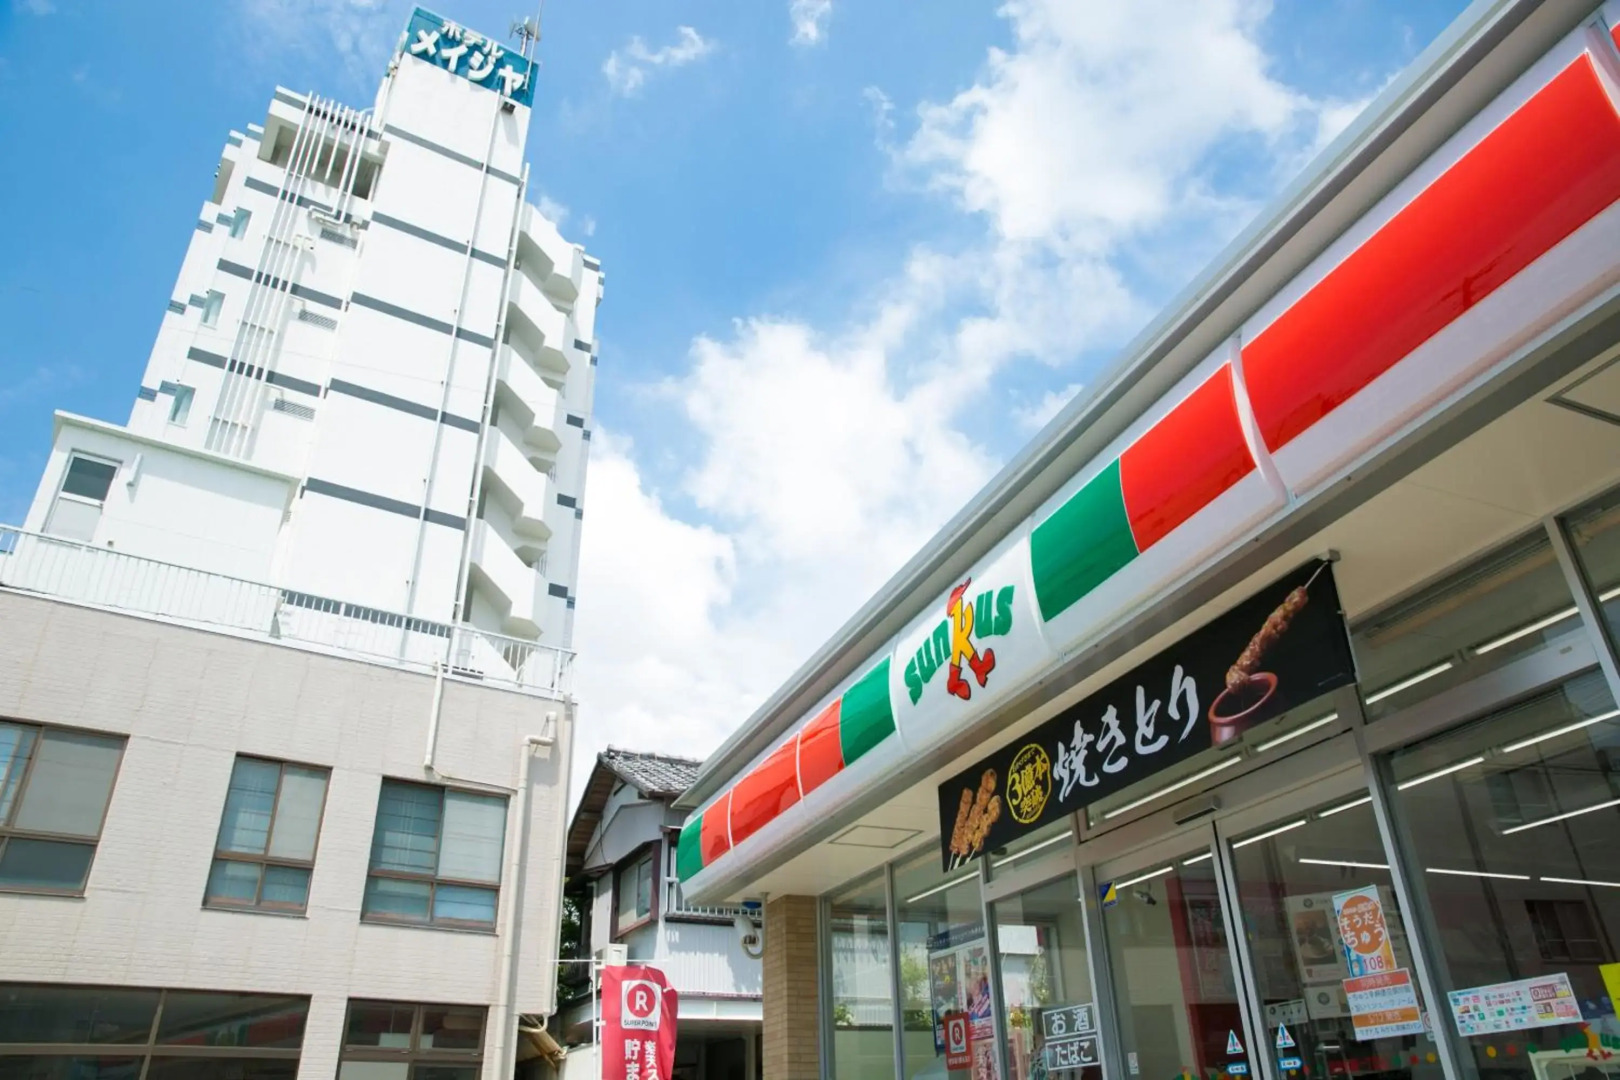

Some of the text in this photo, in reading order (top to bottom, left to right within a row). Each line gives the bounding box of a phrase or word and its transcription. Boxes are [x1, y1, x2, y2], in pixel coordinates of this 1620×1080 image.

[1053, 664, 1199, 803] 焼きとり
[1363, 955, 1384, 971] 108
[635, 990, 648, 1011] R
[1051, 1007, 1090, 1035] お酒
[1055, 1041, 1093, 1066] たばこ
